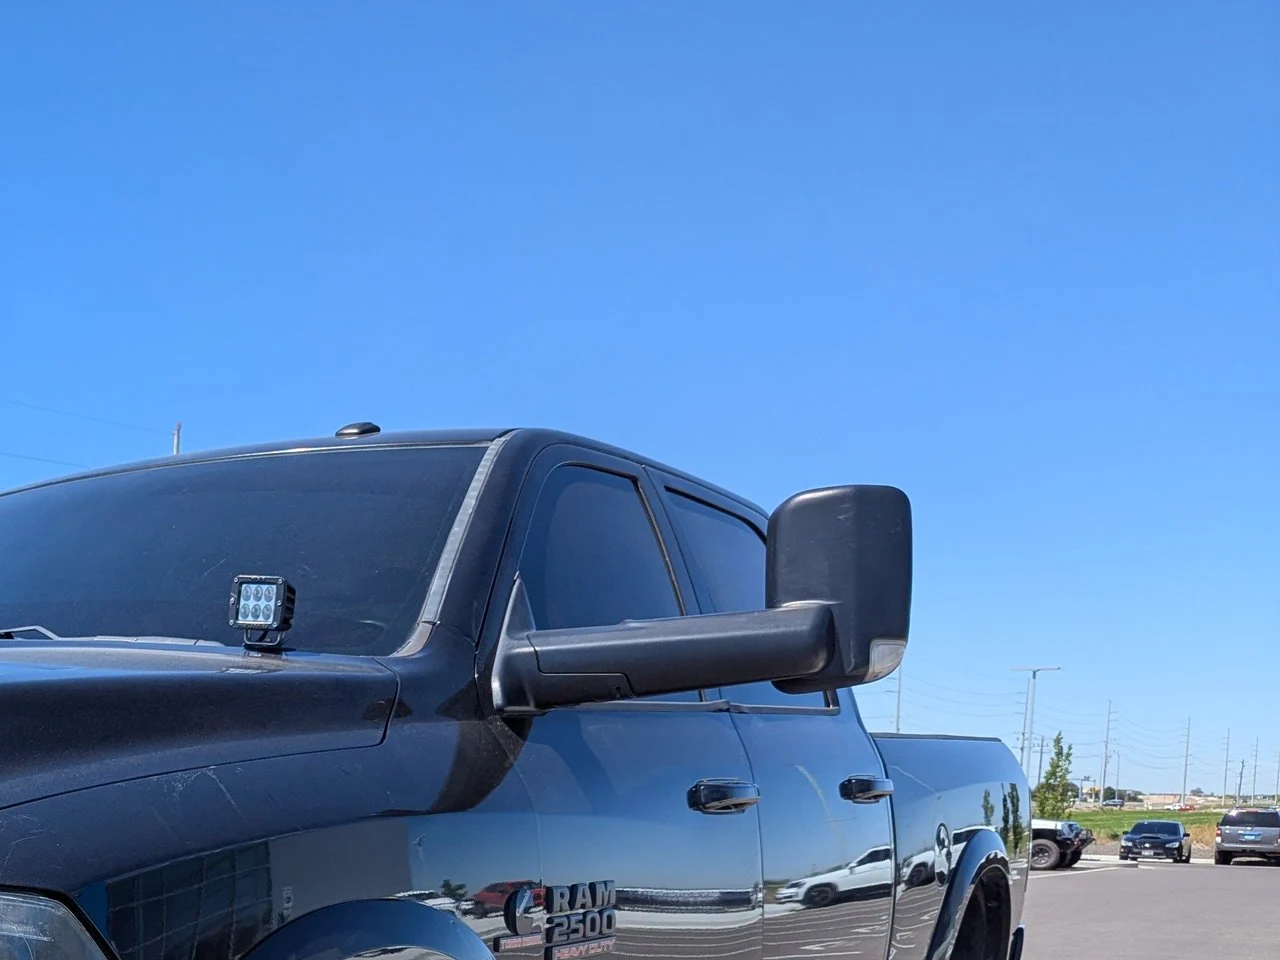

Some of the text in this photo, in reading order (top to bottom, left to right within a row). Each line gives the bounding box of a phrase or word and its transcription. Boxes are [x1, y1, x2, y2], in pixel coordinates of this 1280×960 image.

[550, 880, 616, 914] RAM
[549, 908, 617, 943] 2500
[554, 938, 616, 960] HEAVY DUTY
